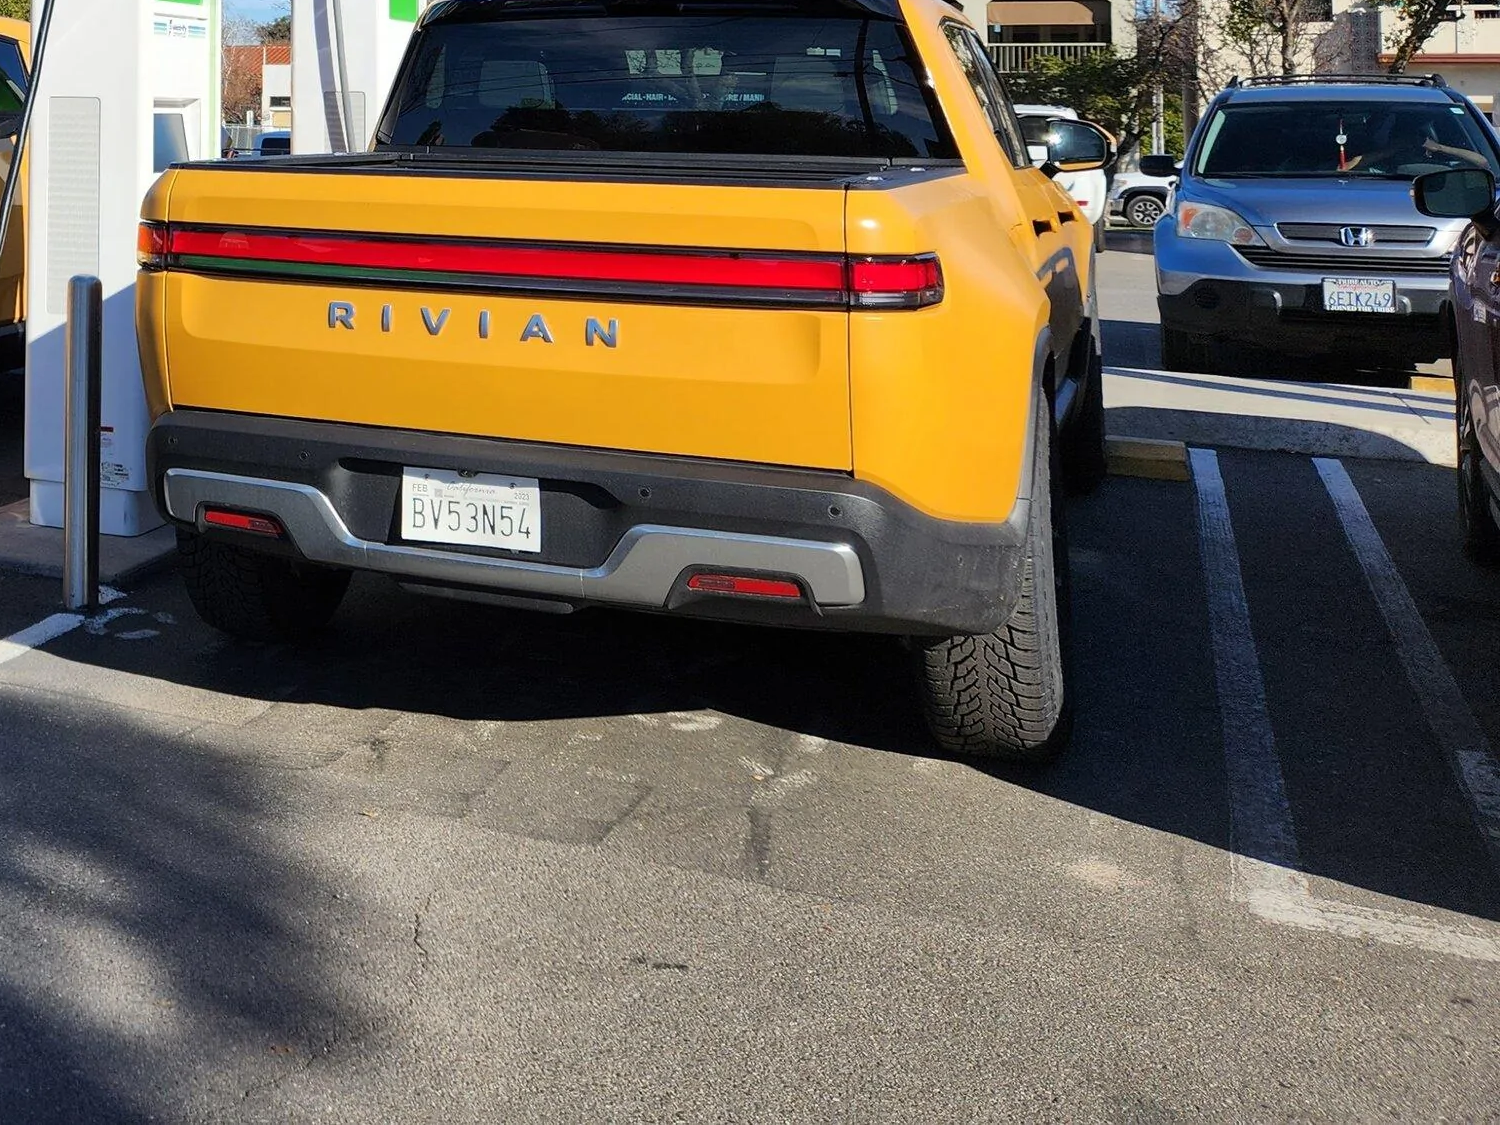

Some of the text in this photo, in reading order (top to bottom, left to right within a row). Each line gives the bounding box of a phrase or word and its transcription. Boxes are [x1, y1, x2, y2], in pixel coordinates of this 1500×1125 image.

[328, 300, 620, 349] RIVIAN
[412, 483, 428, 493] FEB
[446, 481, 497, 498] California
[514, 492, 531, 501] 2023
[412, 497, 531, 540] BV53N54
